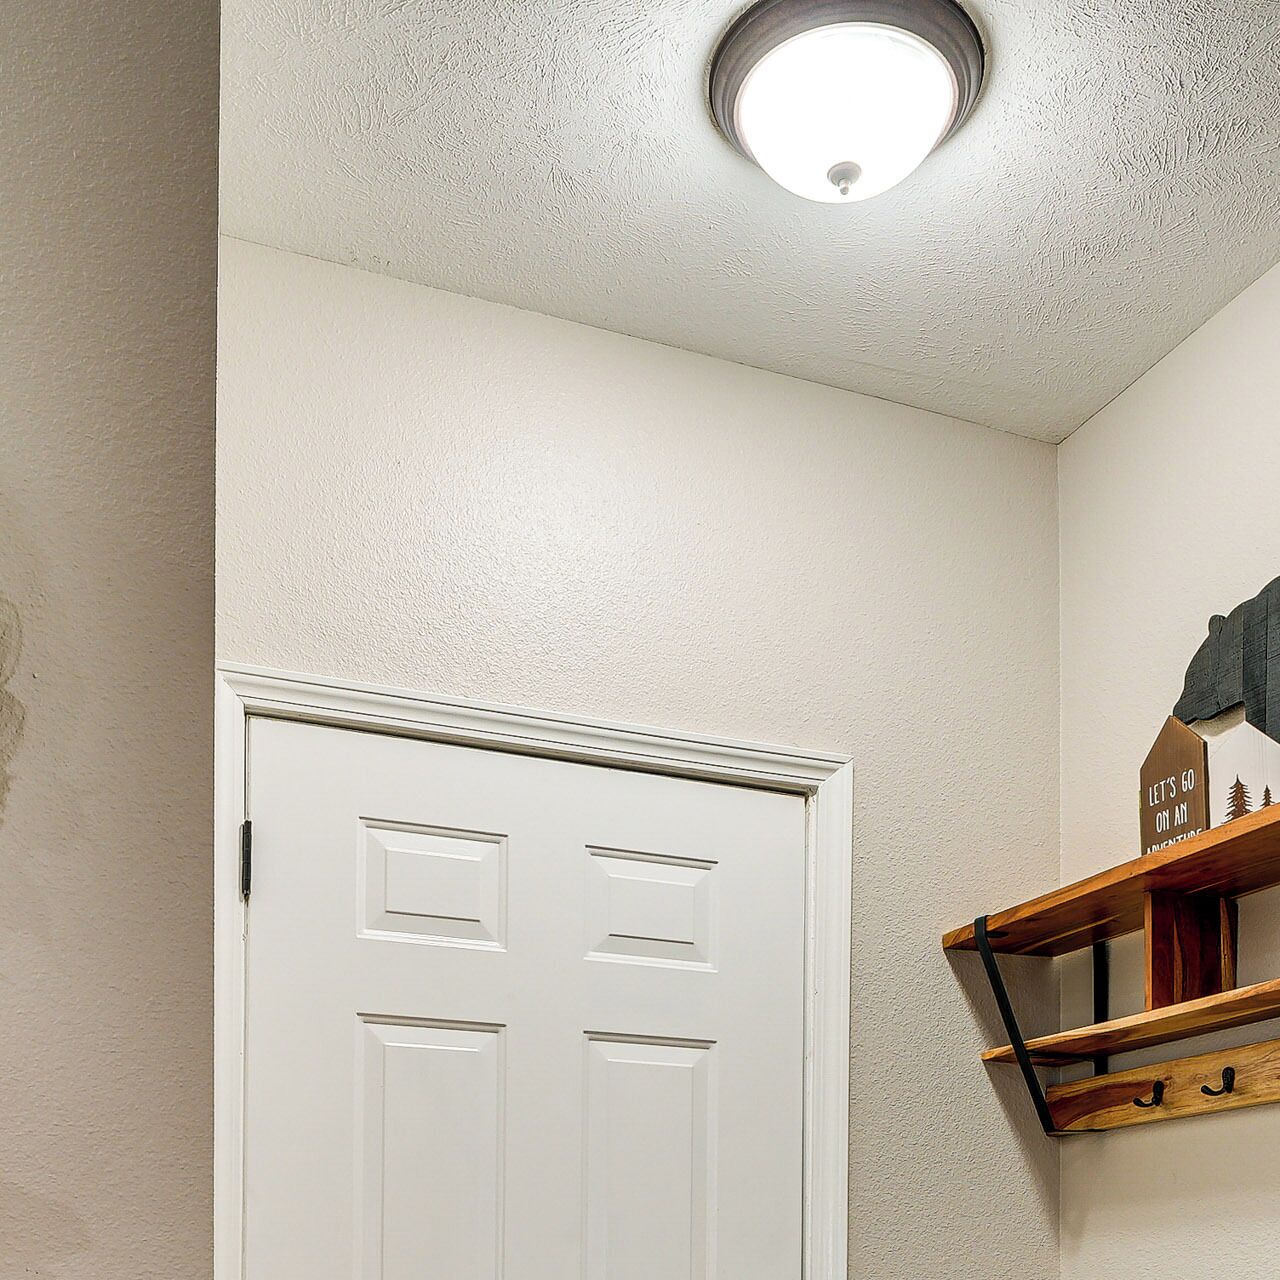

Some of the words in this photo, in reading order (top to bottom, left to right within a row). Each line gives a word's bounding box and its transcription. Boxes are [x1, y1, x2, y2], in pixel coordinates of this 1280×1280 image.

[1149, 776, 1177, 807] LET'S
[1181, 768, 1195, 793] GO
[1156, 808, 1170, 834] ON
[1174, 801, 1188, 827] AN
